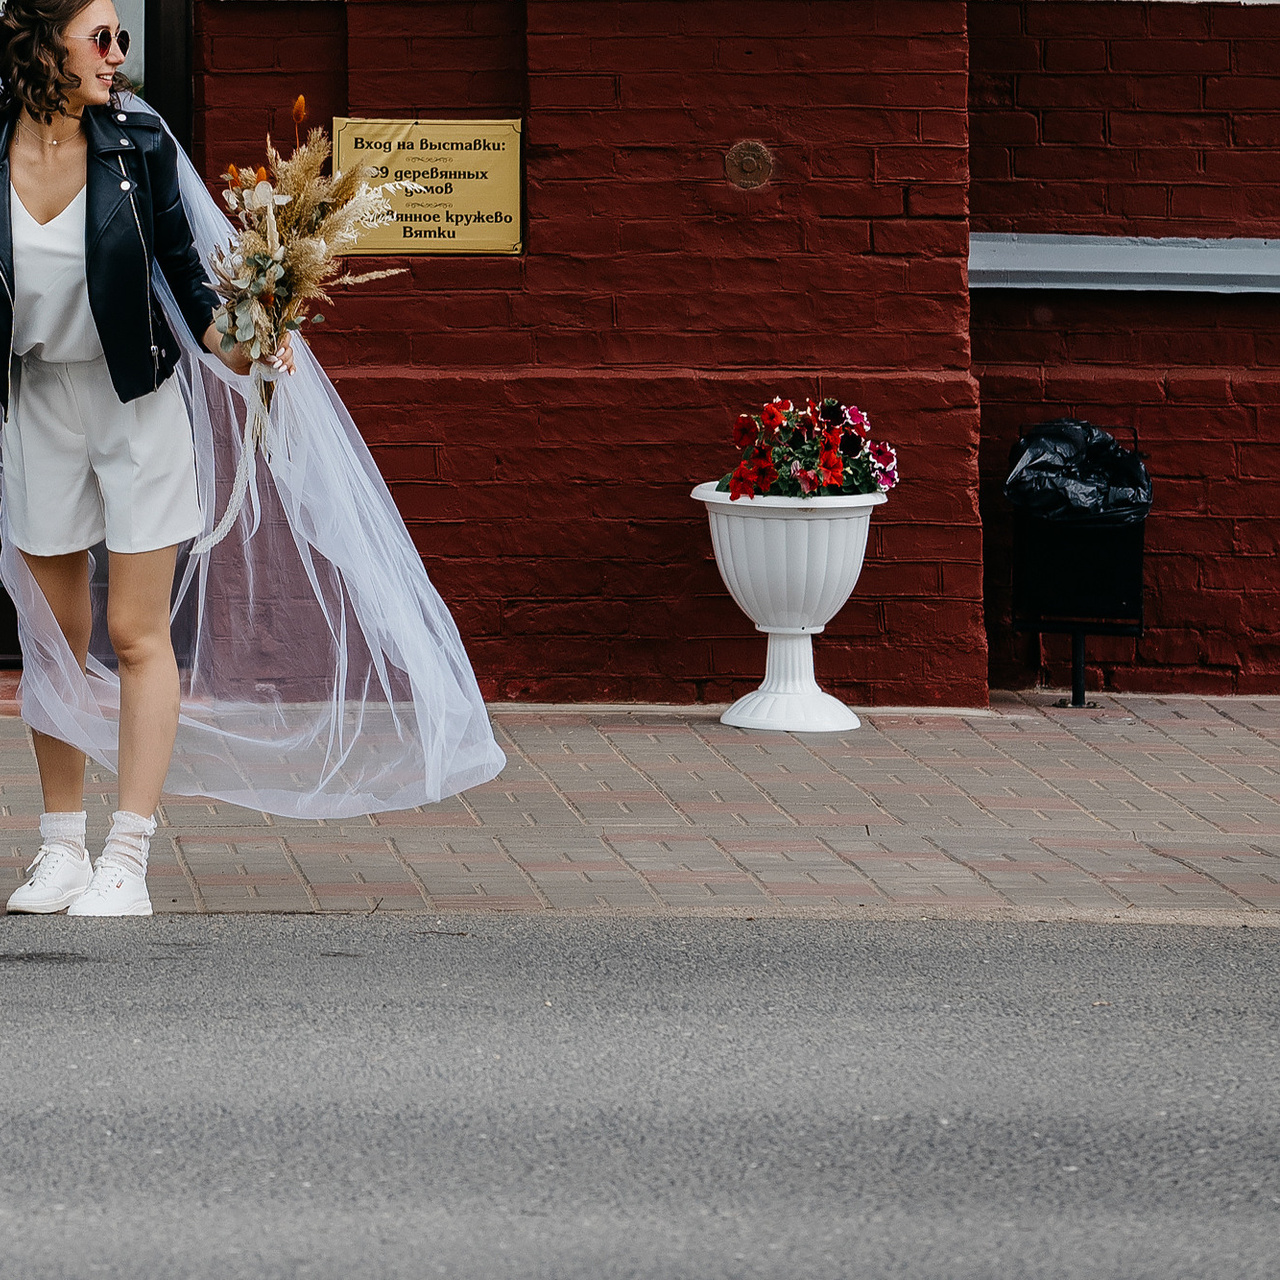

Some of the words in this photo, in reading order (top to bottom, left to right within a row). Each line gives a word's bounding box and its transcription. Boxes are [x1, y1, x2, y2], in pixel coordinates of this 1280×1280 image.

[353, 137, 392, 153] Вход
[397, 141, 415, 151] на
[419, 138, 506, 152] выставки:
[394, 167, 489, 183] деревянных
[445, 210, 514, 227] кружево
[402, 226, 457, 240] Вятки
